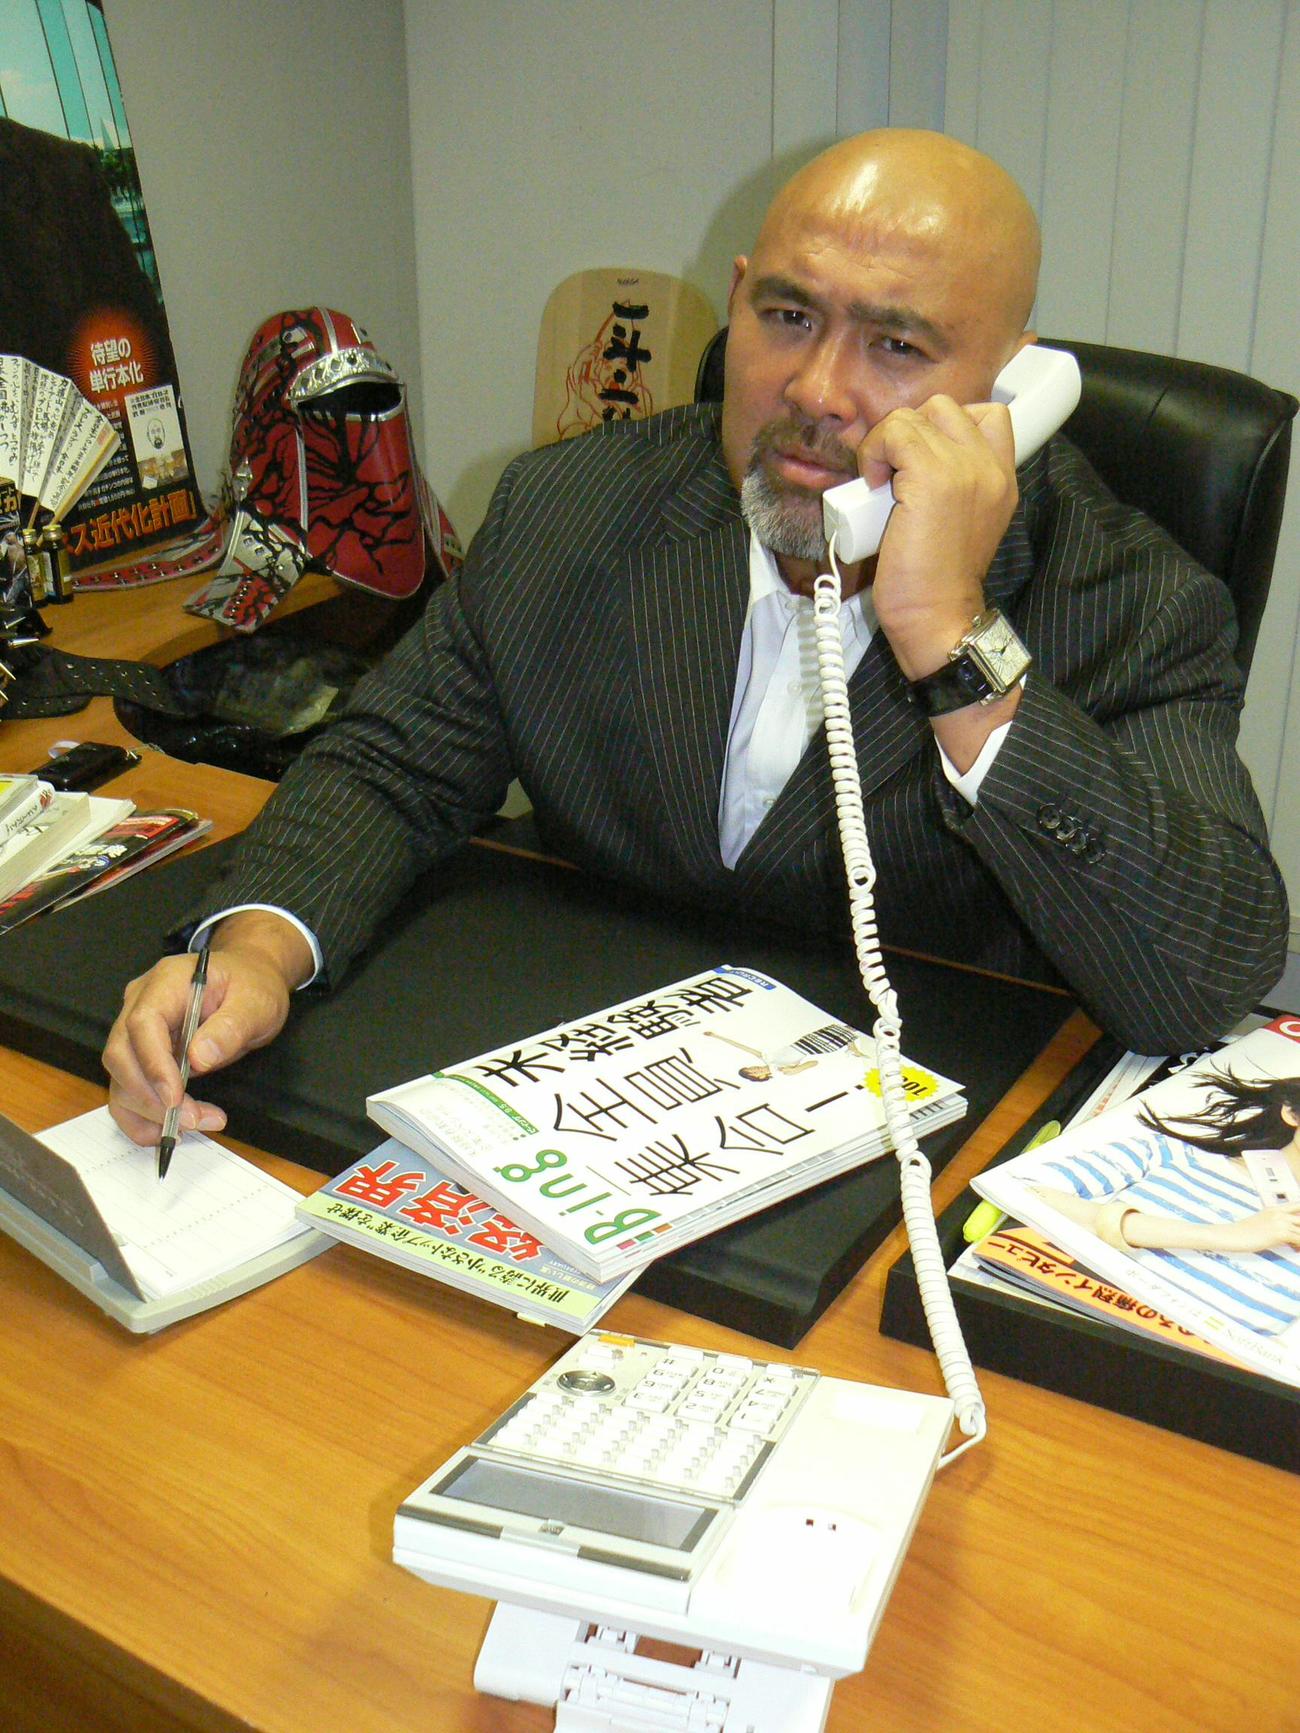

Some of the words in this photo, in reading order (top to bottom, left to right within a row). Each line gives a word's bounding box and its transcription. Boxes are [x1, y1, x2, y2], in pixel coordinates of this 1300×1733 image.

[89, 361, 144, 393] 単行本化
[90, 337, 132, 366] 待望の
[474, 976, 755, 1089] 未経験者
[552, 1046, 741, 1143] 全員
[324, 1160, 547, 1262] 経済界
[494, 1149, 661, 1247] B-ing
